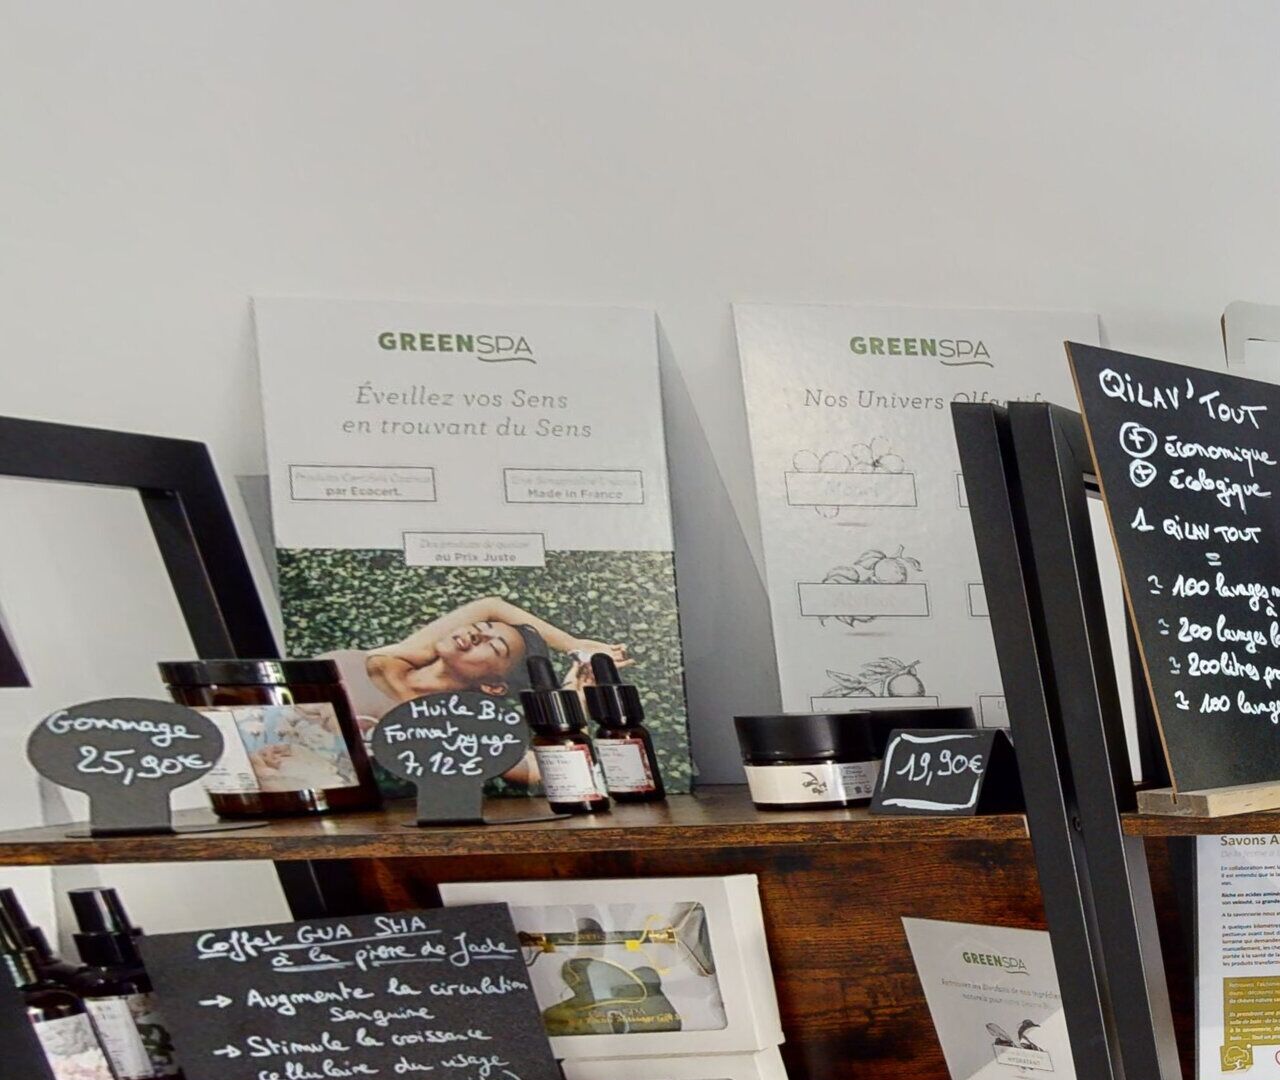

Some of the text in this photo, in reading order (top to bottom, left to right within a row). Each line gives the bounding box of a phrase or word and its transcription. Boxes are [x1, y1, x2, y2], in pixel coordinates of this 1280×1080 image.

[377, 331, 534, 360] GREENSPA
[849, 336, 992, 363] GREENSPA
[355, 381, 569, 410] Éveillez vos Sens
[804, 389, 848, 408] Nos
[858, 390, 944, 410] Univers
[341, 417, 593, 439] en trouvant du Sens
[1164, 435, 1277, 477] économique
[325, 488, 347, 500] par
[527, 488, 624, 500] Made France
[1170, 468, 1272, 514] écologique
[1131, 507, 1155, 532] 1
[1172, 574, 1210, 597] 100
[1215, 572, 1270, 611] lavages
[1178, 613, 1268, 653] 200 lavages
[1187, 652, 1220, 676] 200
[410, 696, 520, 725] Huile Bio
[1200, 693, 1230, 713] 100
[47, 710, 201, 746] Gommage
[384, 722, 459, 743] Format
[1220, 834, 1266, 846] Savons
[297, 916, 426, 944] GUA SHA
[308, 932, 518, 966] la de Jade
[962, 951, 1030, 975] GREENSPA
[245, 982, 374, 1014] Augmente
[388, 977, 421, 996] la
[246, 1032, 352, 1057] Stimule
[357, 1027, 384, 1047] la
